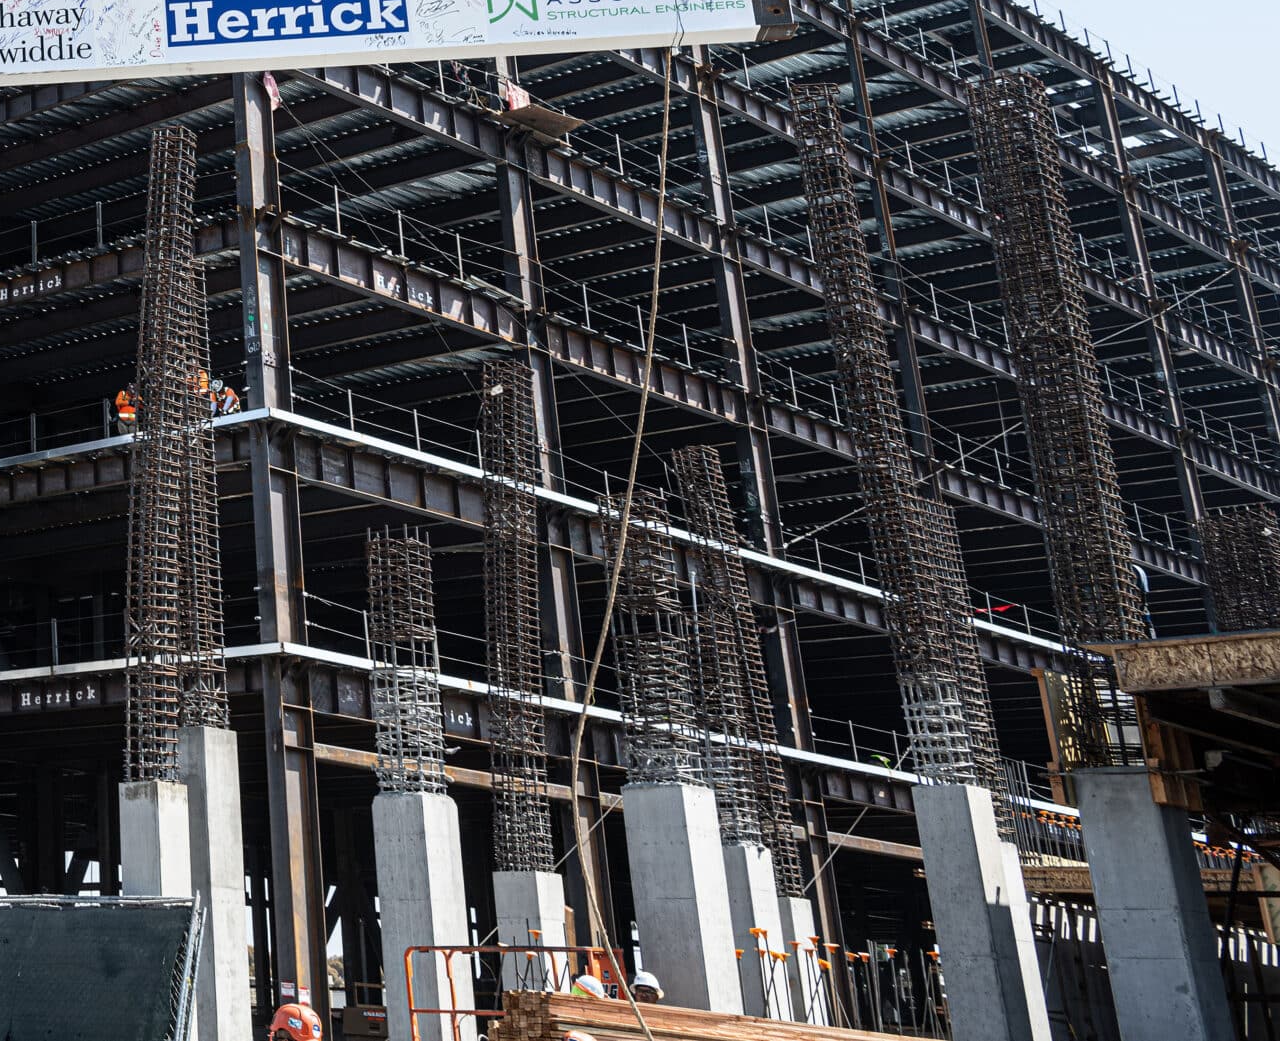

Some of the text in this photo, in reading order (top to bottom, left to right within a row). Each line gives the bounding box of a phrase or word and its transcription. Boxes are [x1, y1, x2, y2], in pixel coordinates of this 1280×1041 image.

[547, 0, 746, 21] STRUCTURAL ENGINEERS
[0, 275, 62, 301] Herrick
[21, 685, 96, 707] Herrick
